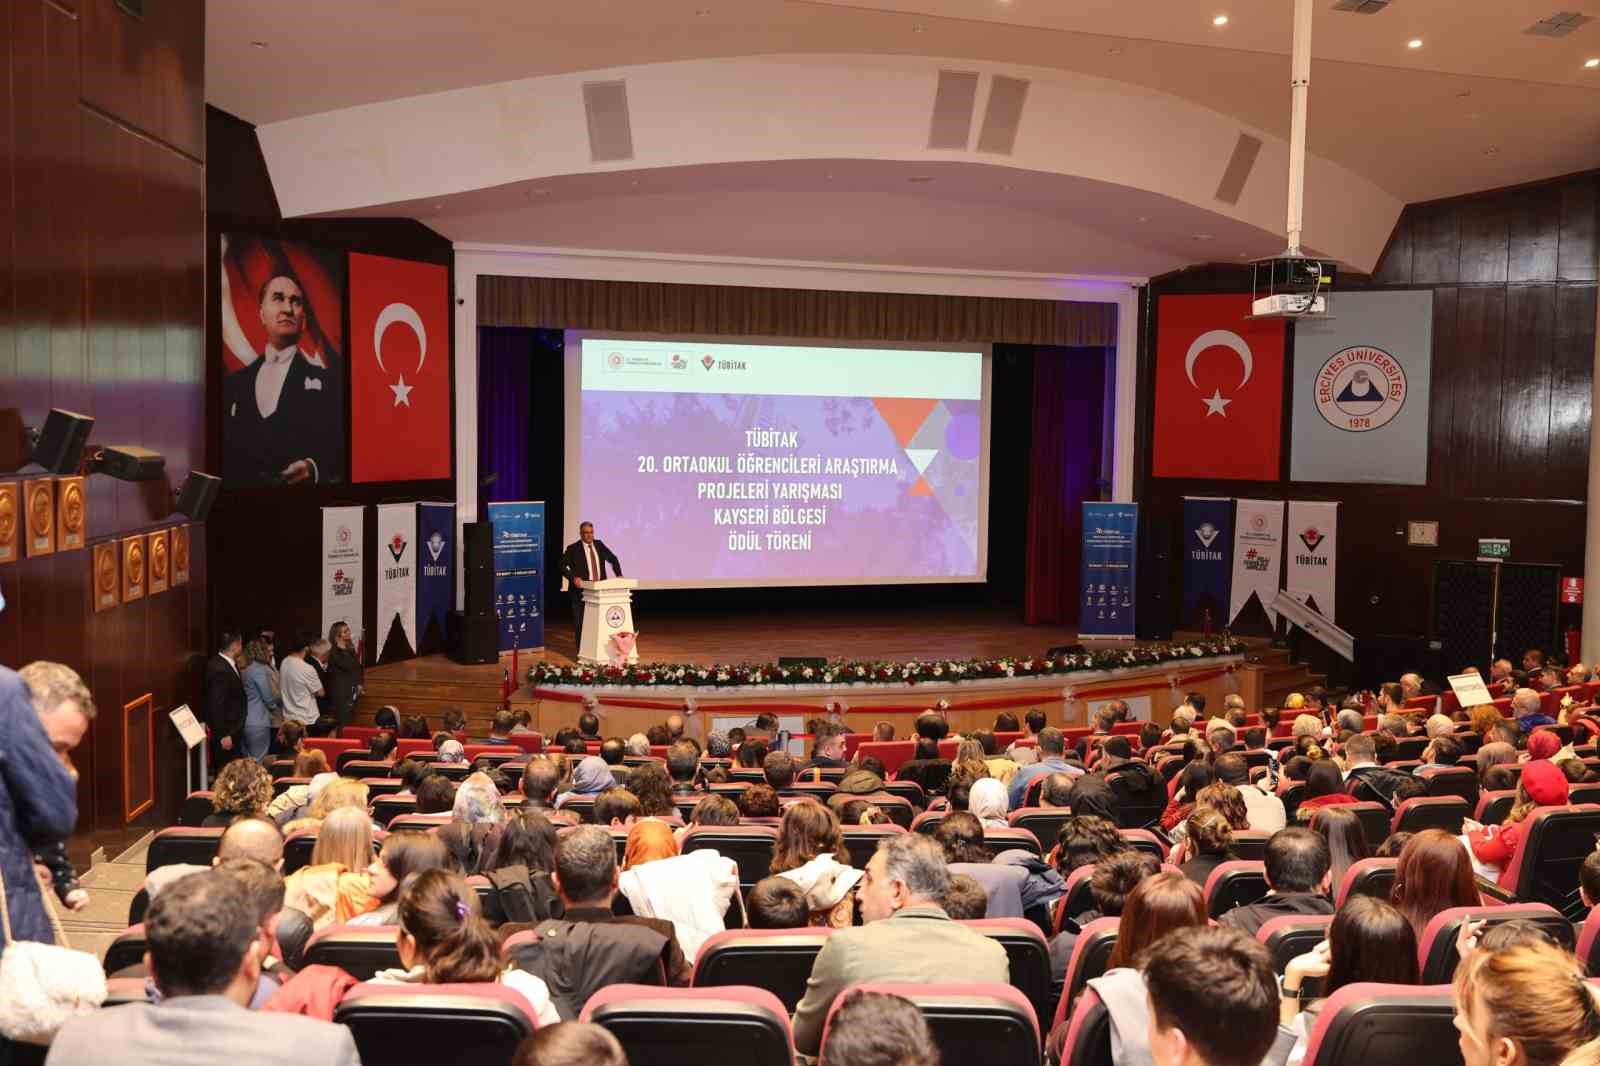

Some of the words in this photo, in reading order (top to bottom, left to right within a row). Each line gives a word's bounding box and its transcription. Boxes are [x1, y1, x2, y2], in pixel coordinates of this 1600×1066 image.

[718, 359, 747, 371] TÜBİTAK
[1349, 418, 1370, 428] 1978
[744, 427, 798, 448] TÜBİTAK
[637, 455, 659, 473] 20.
[663, 456, 733, 473] ORTAOKUL
[737, 452, 821, 474] ÖĞRENCİLERİ
[825, 457, 898, 478] ARAŞTIRMA
[697, 480, 769, 499] PROJELERİ
[772, 483, 842, 503] YARIŞMASI
[714, 505, 769, 525] KAYSERİ
[773, 505, 826, 525] BÖLGESİ
[728, 530, 762, 550] ÖDÜL
[766, 530, 812, 550] TÖRENİ
[1191, 549, 1223, 561] TÜBİTAK
[1296, 554, 1328, 567] TÜBİTAK
[384, 567, 410, 580] TÜBİTAK
[423, 564, 447, 577] TÜBİTAK
